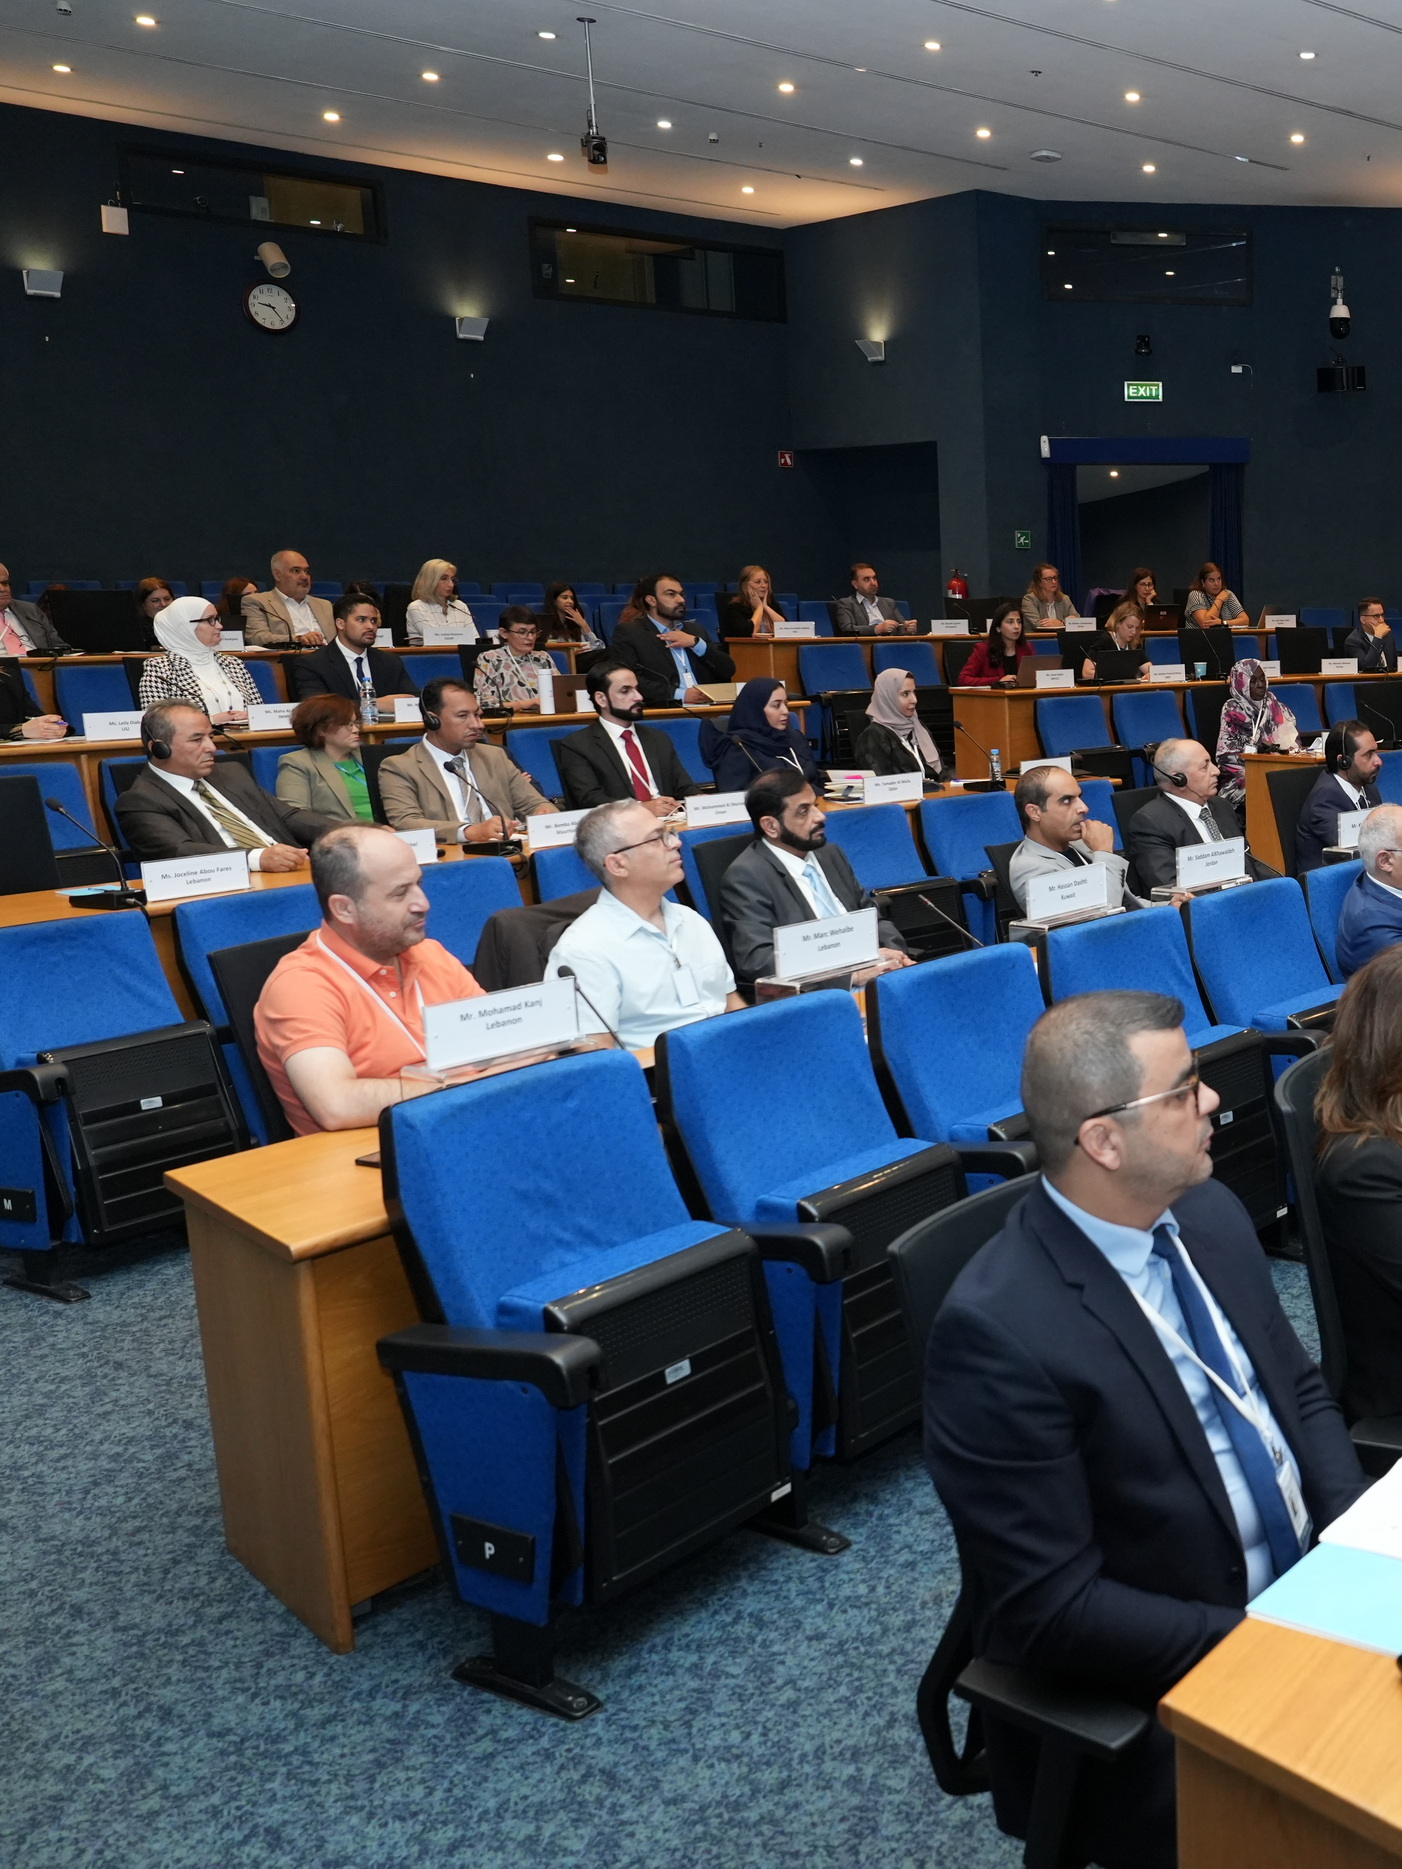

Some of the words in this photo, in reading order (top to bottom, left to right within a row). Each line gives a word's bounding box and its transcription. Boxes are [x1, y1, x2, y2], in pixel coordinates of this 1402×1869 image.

[1129, 385, 1158, 397] EXIT
[1195, 851, 1210, 860] Saddam
[1205, 859, 1218, 868] Jordan
[175, 869, 198, 879] Joceline
[199, 868, 215, 876] Abou
[216, 865, 232, 874] Fares
[186, 876, 212, 886] Lebanon
[1057, 881, 1073, 891] Hassan
[1074, 878, 1088, 888] Dashti
[1061, 891, 1076, 901] Kuwait
[802, 933, 812, 942] Mr.
[814, 931, 829, 941] Marc
[830, 926, 854, 938] Wehaibe
[818, 941, 841, 953] Lebanon
[460, 1013, 476, 1022] Mr.
[478, 1002, 523, 1018] Mohamad
[524, 998, 543, 1010] Kanj
[486, 1016, 523, 1031] Lebanon
[3, 1198, 13, 1210] M
[484, 1541, 495, 1559] P
